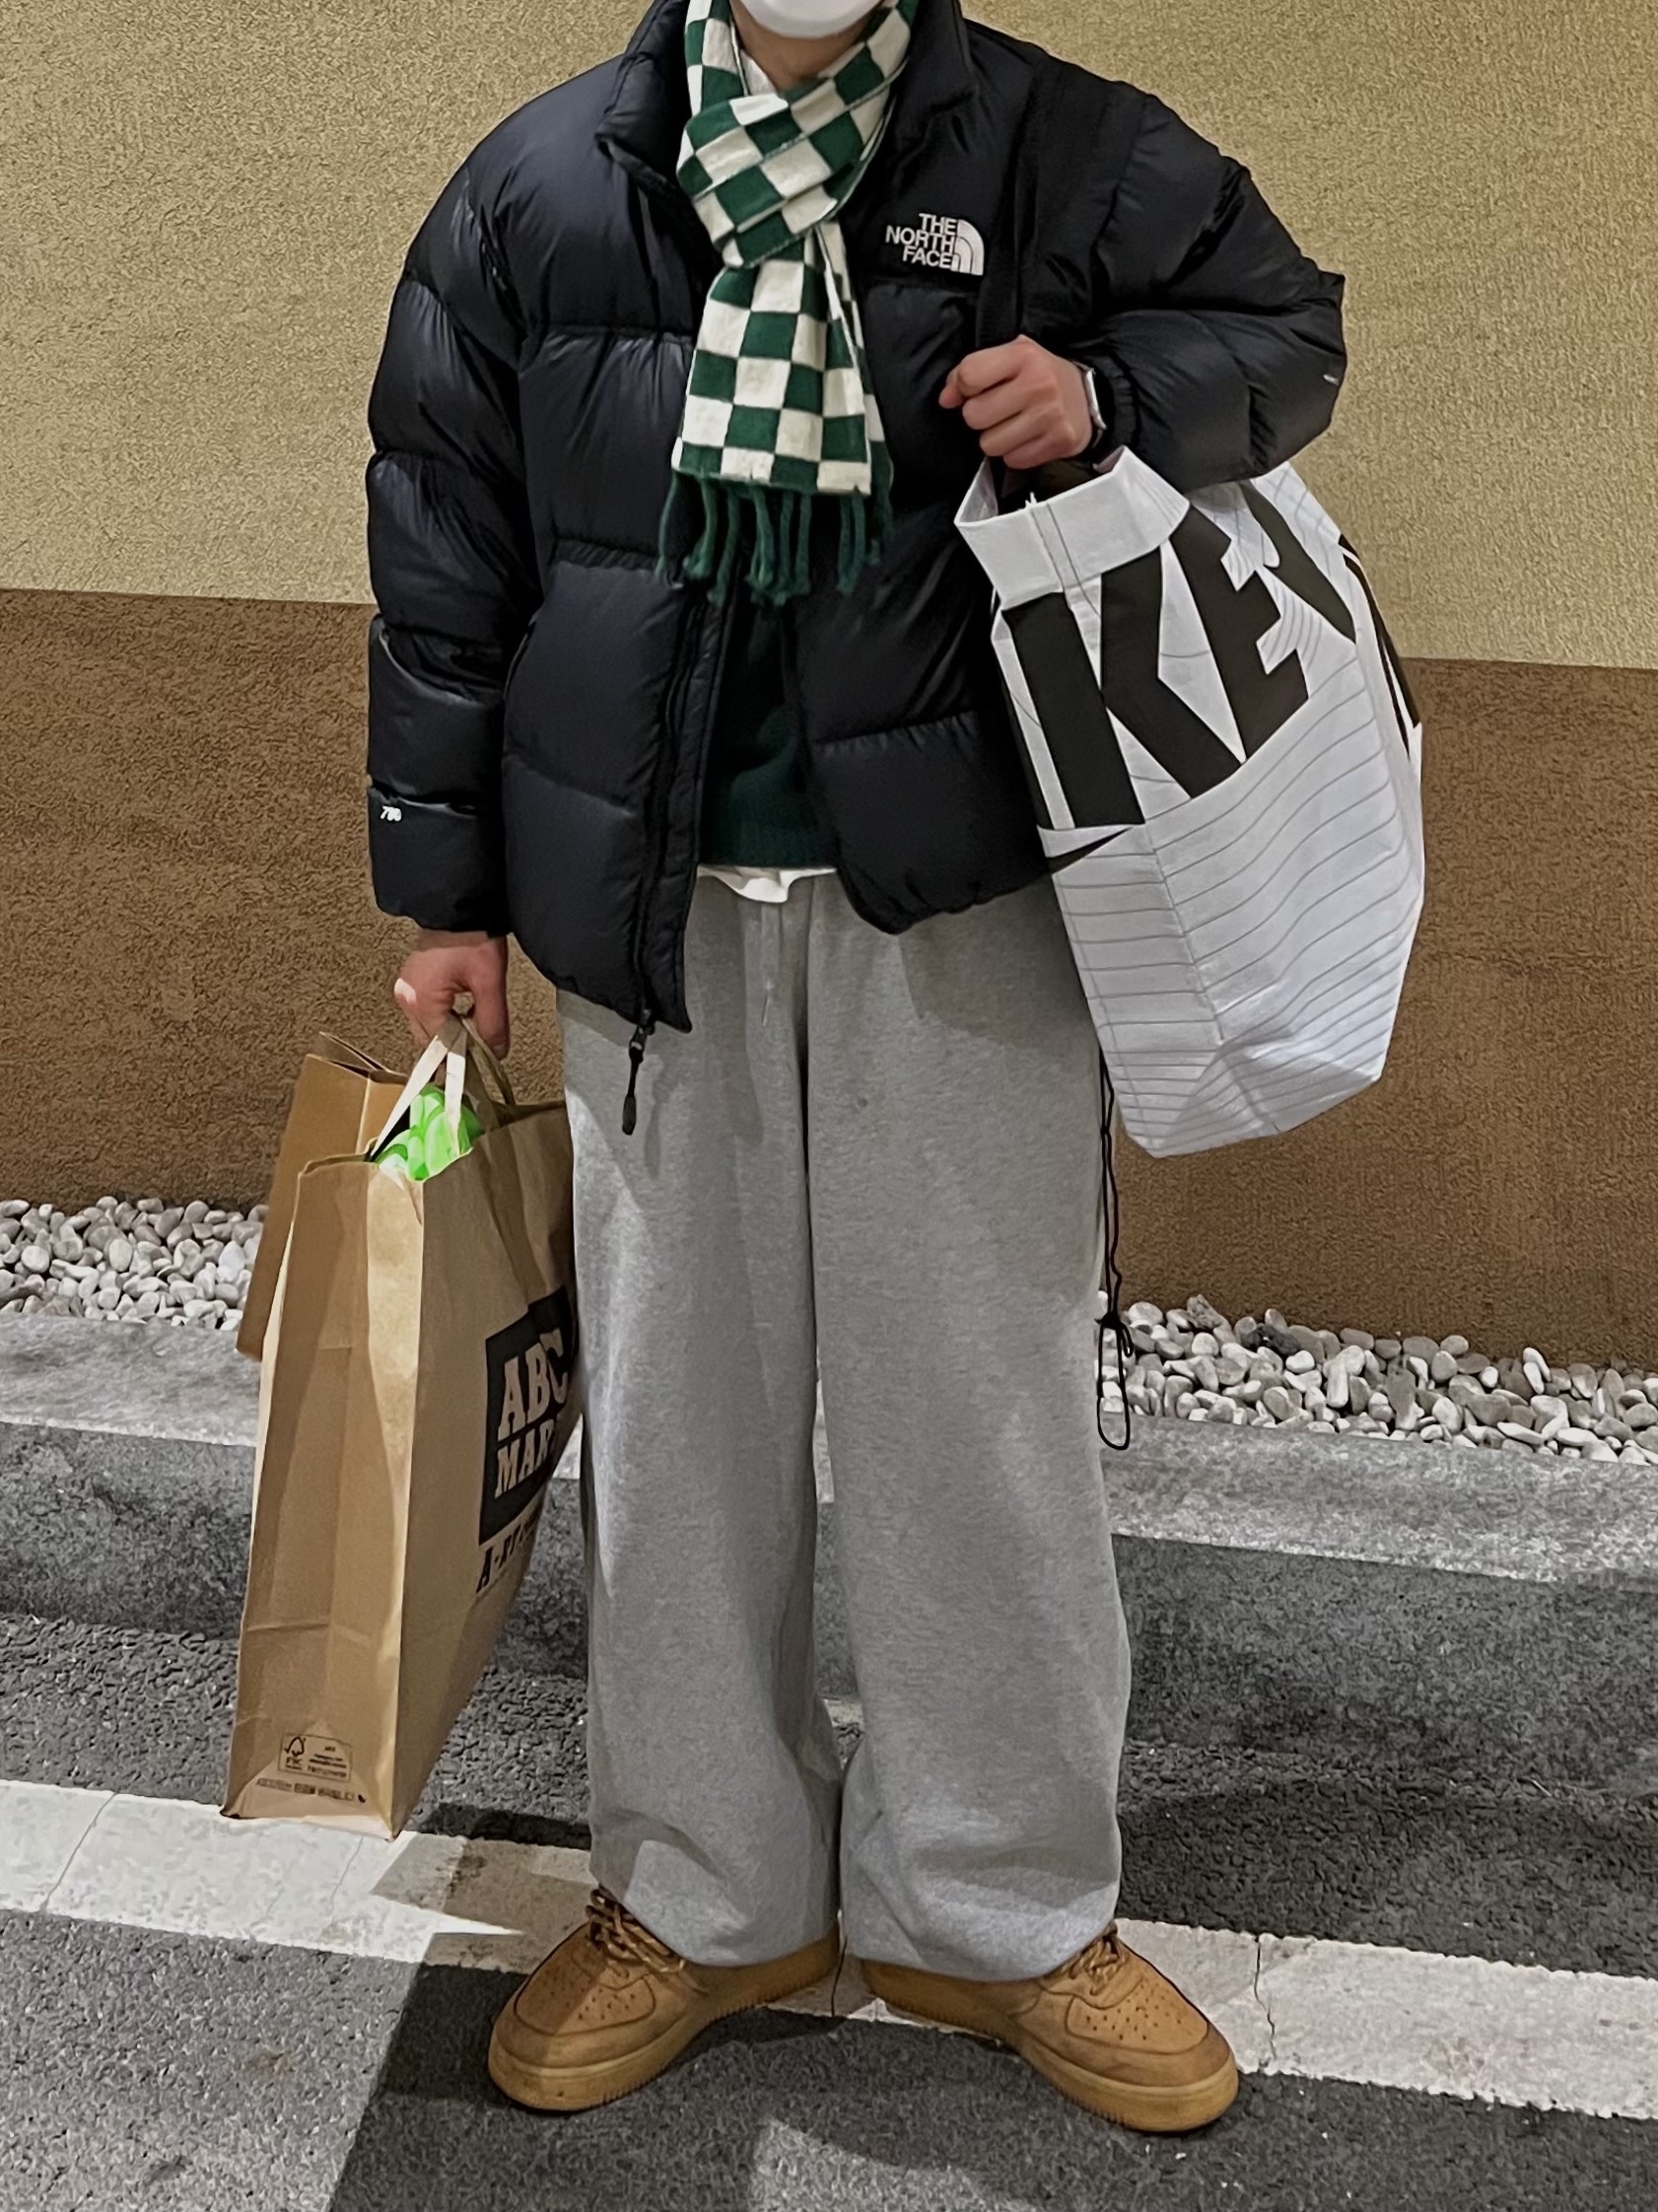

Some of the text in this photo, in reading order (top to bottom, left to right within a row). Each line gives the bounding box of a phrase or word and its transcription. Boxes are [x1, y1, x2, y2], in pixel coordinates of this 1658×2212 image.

[919, 212, 957, 236] THE
[885, 225, 955, 256] NORTH
[902, 245, 953, 269] FACE
[498, 1327, 569, 1442] ABC
[494, 1418, 555, 1499] MAR
